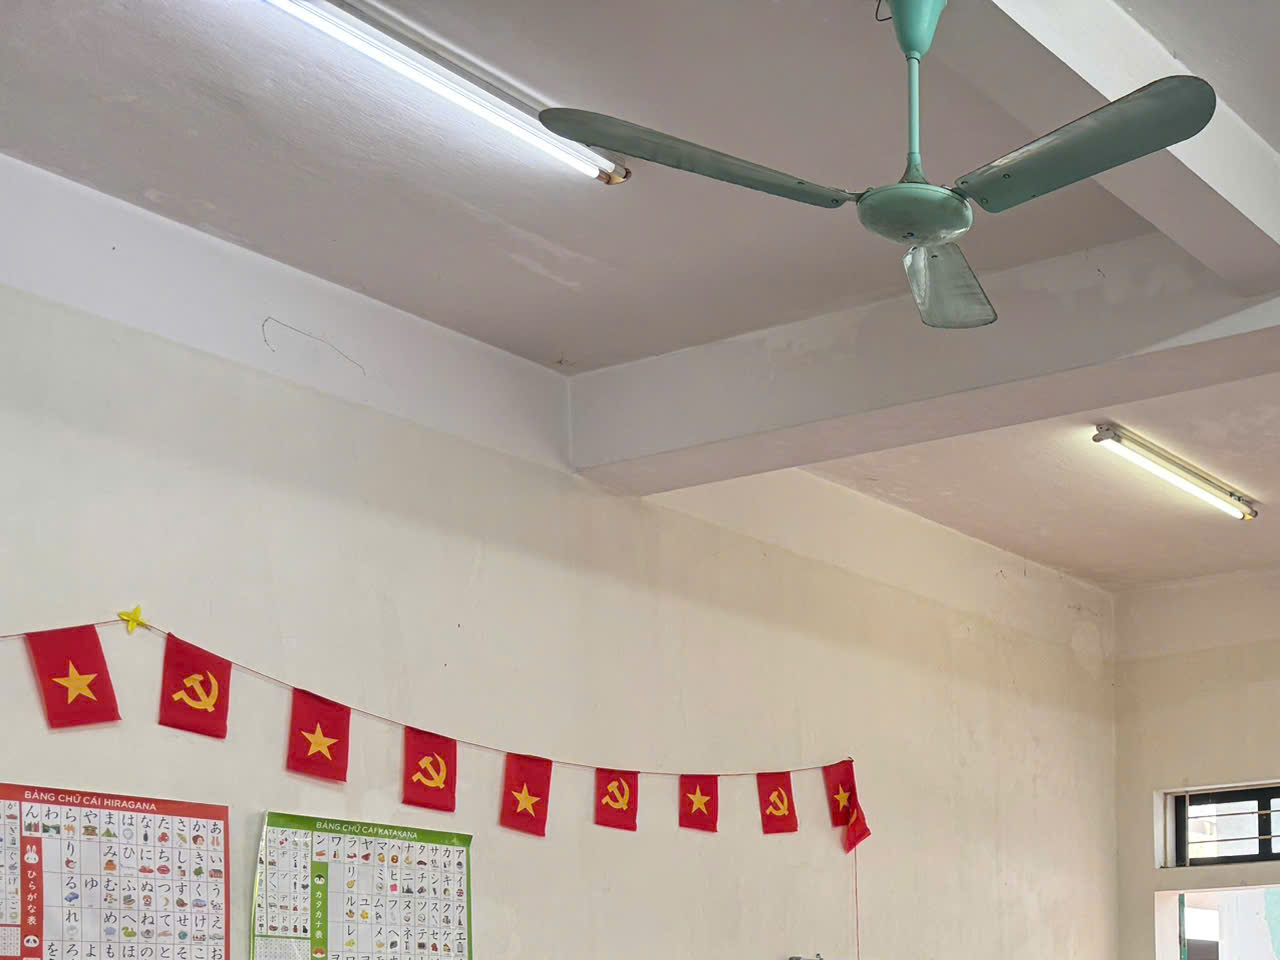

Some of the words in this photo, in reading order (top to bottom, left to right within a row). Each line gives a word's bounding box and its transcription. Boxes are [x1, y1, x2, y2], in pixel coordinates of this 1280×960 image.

[24, 789, 56, 801] BẢNG
[58, 793, 81, 804] CHỮ
[82, 795, 101, 806] CÁI
[103, 798, 157, 811] HIRAGANA
[25, 805, 39, 819] ん
[45, 806, 59, 820] わ
[66, 808, 77, 822] ら
[83, 810, 98, 824] や
[104, 811, 115, 825] ま
[122, 814, 134, 826] は
[141, 815, 152, 829] な
[158, 815, 171, 830] た
[177, 818, 186, 832] さ
[193, 820, 206, 832] か
[210, 820, 223, 835] あ
[378, 828, 417, 839] KATAKANA
[67, 841, 75, 856] り
[103, 845, 118, 857] み
[123, 847, 135, 859] ひ
[140, 848, 152, 861] に
[159, 849, 170, 862] ち
[178, 850, 187, 864] し
[195, 851, 204, 865] き
[210, 855, 222, 864] い
[317, 835, 325, 845] ン
[331, 836, 342, 846] ワ
[348, 837, 357, 848] ラ
[361, 838, 373, 850] ヤ
[377, 842, 387, 850] マ
[405, 843, 414, 854] ナ
[419, 844, 426, 855] タ
[430, 846, 439, 856] サ
[443, 847, 451, 858] カ
[456, 849, 464, 859] ア
[66, 876, 77, 890] る
[85, 877, 98, 890] ゆ
[104, 878, 118, 892] む
[122, 880, 136, 892] ふ
[141, 881, 154, 892] ぬ
[158, 884, 171, 892] つ
[176, 882, 188, 896] す
[196, 883, 201, 897] く
[212, 884, 220, 897] う
[348, 866, 355, 877] リ
[377, 866, 384, 881] ミ
[391, 870, 398, 881] ヒ
[402, 873, 413, 881] ニ
[417, 872, 427, 883] チ
[443, 874, 452, 885] キ
[457, 876, 463, 887] イ
[27, 870, 38, 926] ひらがな表
[346, 896, 356, 907] ル
[359, 898, 370, 906] ユ
[374, 898, 384, 908] ム
[388, 900, 398, 910] フ
[404, 901, 411, 910] ヌ
[417, 901, 427, 911] ツ
[431, 902, 439, 912] ス
[443, 903, 451, 913] ク
[456, 904, 465, 914] ウ
[65, 909, 79, 923] れ
[104, 911, 117, 924] め
[122, 915, 137, 923] へ
[141, 913, 155, 925] ね
[160, 914, 171, 927] て
[177, 914, 189, 927] せ
[195, 915, 207, 928] け
[212, 916, 222, 929] え
[347, 925, 355, 936] レ
[376, 927, 382, 937] メ
[388, 929, 399, 937] ヘ
[403, 927, 413, 940] ネ
[417, 929, 427, 940] テ
[430, 930, 439, 940] セ
[442, 930, 452, 941] ケ
[455, 932, 466, 941] エ
[47, 943, 58, 957] を
[66, 944, 79, 956] ろ
[86, 944, 96, 957] よ
[106, 944, 115, 958] も
[123, 945, 135, 958] ほ
[140, 947, 154, 957] の
[160, 947, 170, 959] と
[177, 947, 187, 959] そ
[195, 948, 205, 959] こ
[211, 947, 223, 960] お
